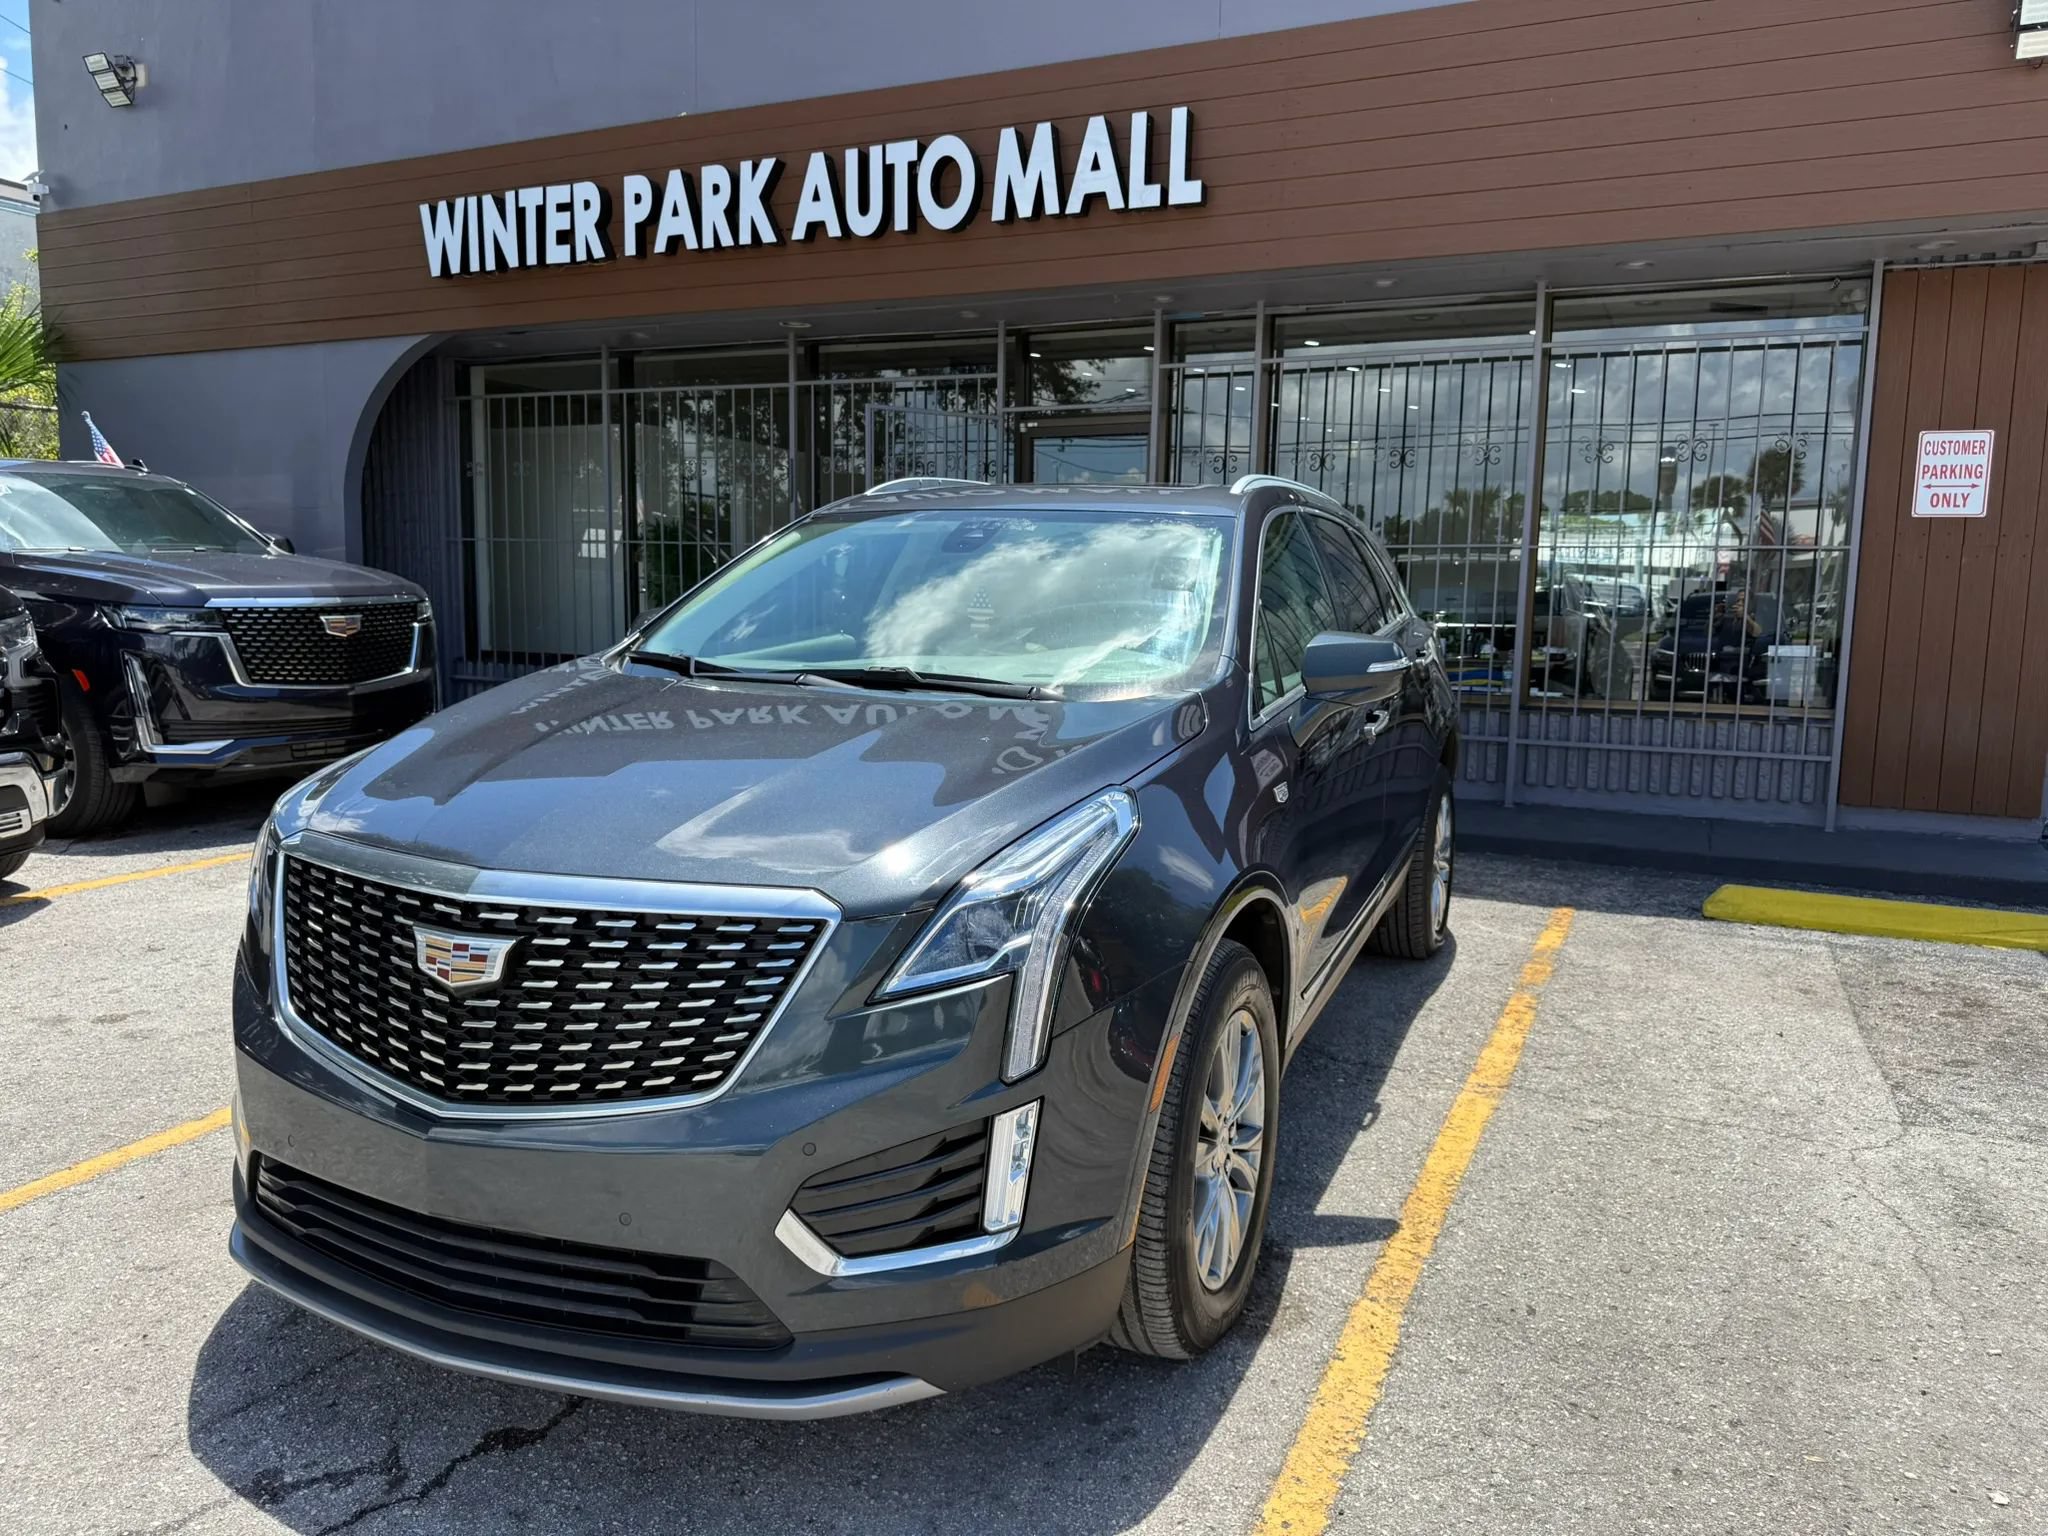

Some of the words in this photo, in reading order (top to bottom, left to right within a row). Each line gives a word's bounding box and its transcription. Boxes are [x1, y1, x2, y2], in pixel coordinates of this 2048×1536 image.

[419, 181, 607, 278] WINTER
[623, 157, 779, 257] PARK
[791, 134, 979, 241] AUTO
[991, 106, 1203, 222] MALL
[1924, 440, 1986, 455] CUSTOMER
[1921, 464, 1984, 479] PARKING
[1930, 493, 1970, 508] ONLY
